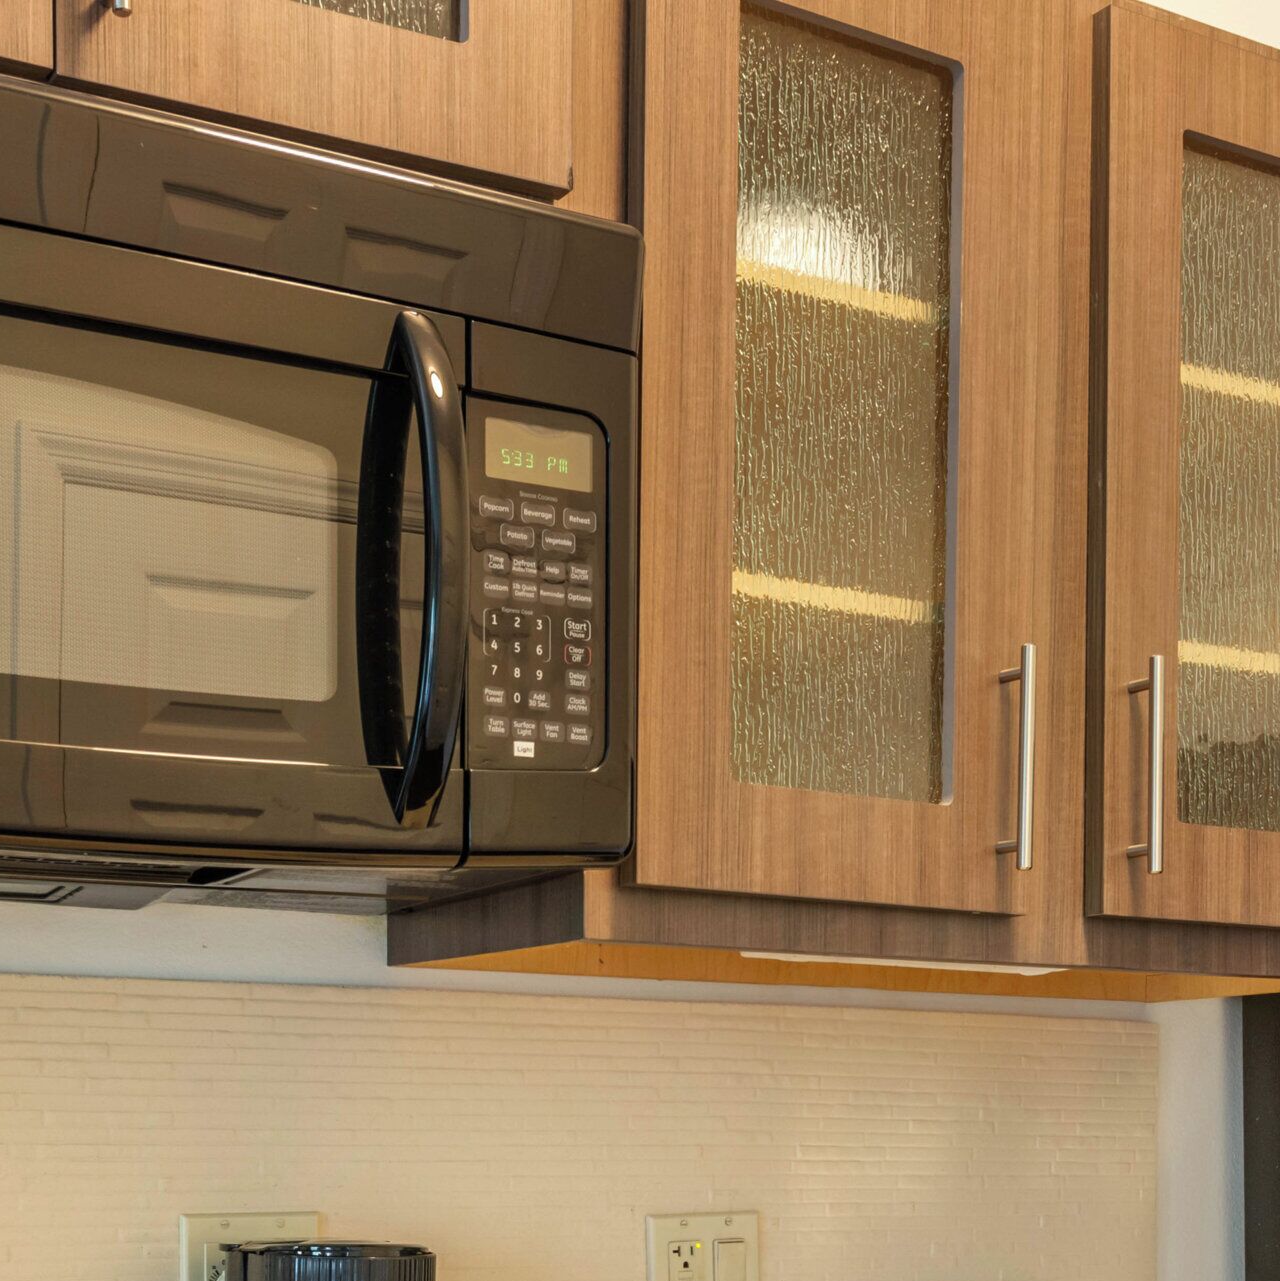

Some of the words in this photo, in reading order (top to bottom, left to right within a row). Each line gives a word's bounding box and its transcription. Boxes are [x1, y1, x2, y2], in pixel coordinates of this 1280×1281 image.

[547, 456, 569, 474] PM
[484, 502, 510, 513] Popcorn
[524, 508, 552, 520] Beverage
[569, 516, 590, 525] Reheat
[506, 530, 528, 540] Potato
[544, 536, 573, 547] Vegetable
[488, 554, 504, 563] Time
[488, 562, 504, 570] Cook
[514, 559, 536, 568] Defrost
[546, 566, 560, 574] Help
[571, 566, 588, 574] Timer
[484, 582, 508, 592] Custom
[522, 584, 537, 592] Quick
[514, 590, 534, 598] Defrost
[540, 590, 565, 599] Reminder
[568, 593, 592, 602] Options
[491, 614, 497, 625] 1
[514, 617, 520, 628] 2
[536, 619, 543, 630] 3
[568, 621, 587, 631] Start
[570, 630, 586, 639] Pause
[491, 640, 498, 650] 4
[514, 642, 520, 653] 5
[536, 644, 543, 656] 6
[568, 646, 584, 654] Clear
[572, 654, 582, 663] Off
[491, 664, 498, 676] 7
[514, 667, 520, 678] 8
[536, 670, 543, 680] 9
[569, 672, 586, 682] Delay
[570, 678, 586, 687] Start
[484, 688, 504, 697] Power
[486, 696, 503, 704] Level
[514, 692, 520, 704] 0
[532, 693, 546, 702] Add
[570, 697, 586, 706] Clock
[528, 700, 536, 708] 30
[537, 700, 550, 708] Sec.
[568, 704, 588, 712] AM/PM
[489, 718, 504, 726] Turn
[514, 721, 536, 730] Surface
[488, 725, 506, 734] Table
[516, 728, 532, 736] Light
[544, 724, 560, 732] Vent
[572, 726, 587, 735] Vent
[546, 730, 558, 738] Fan
[570, 733, 588, 741] Boost
